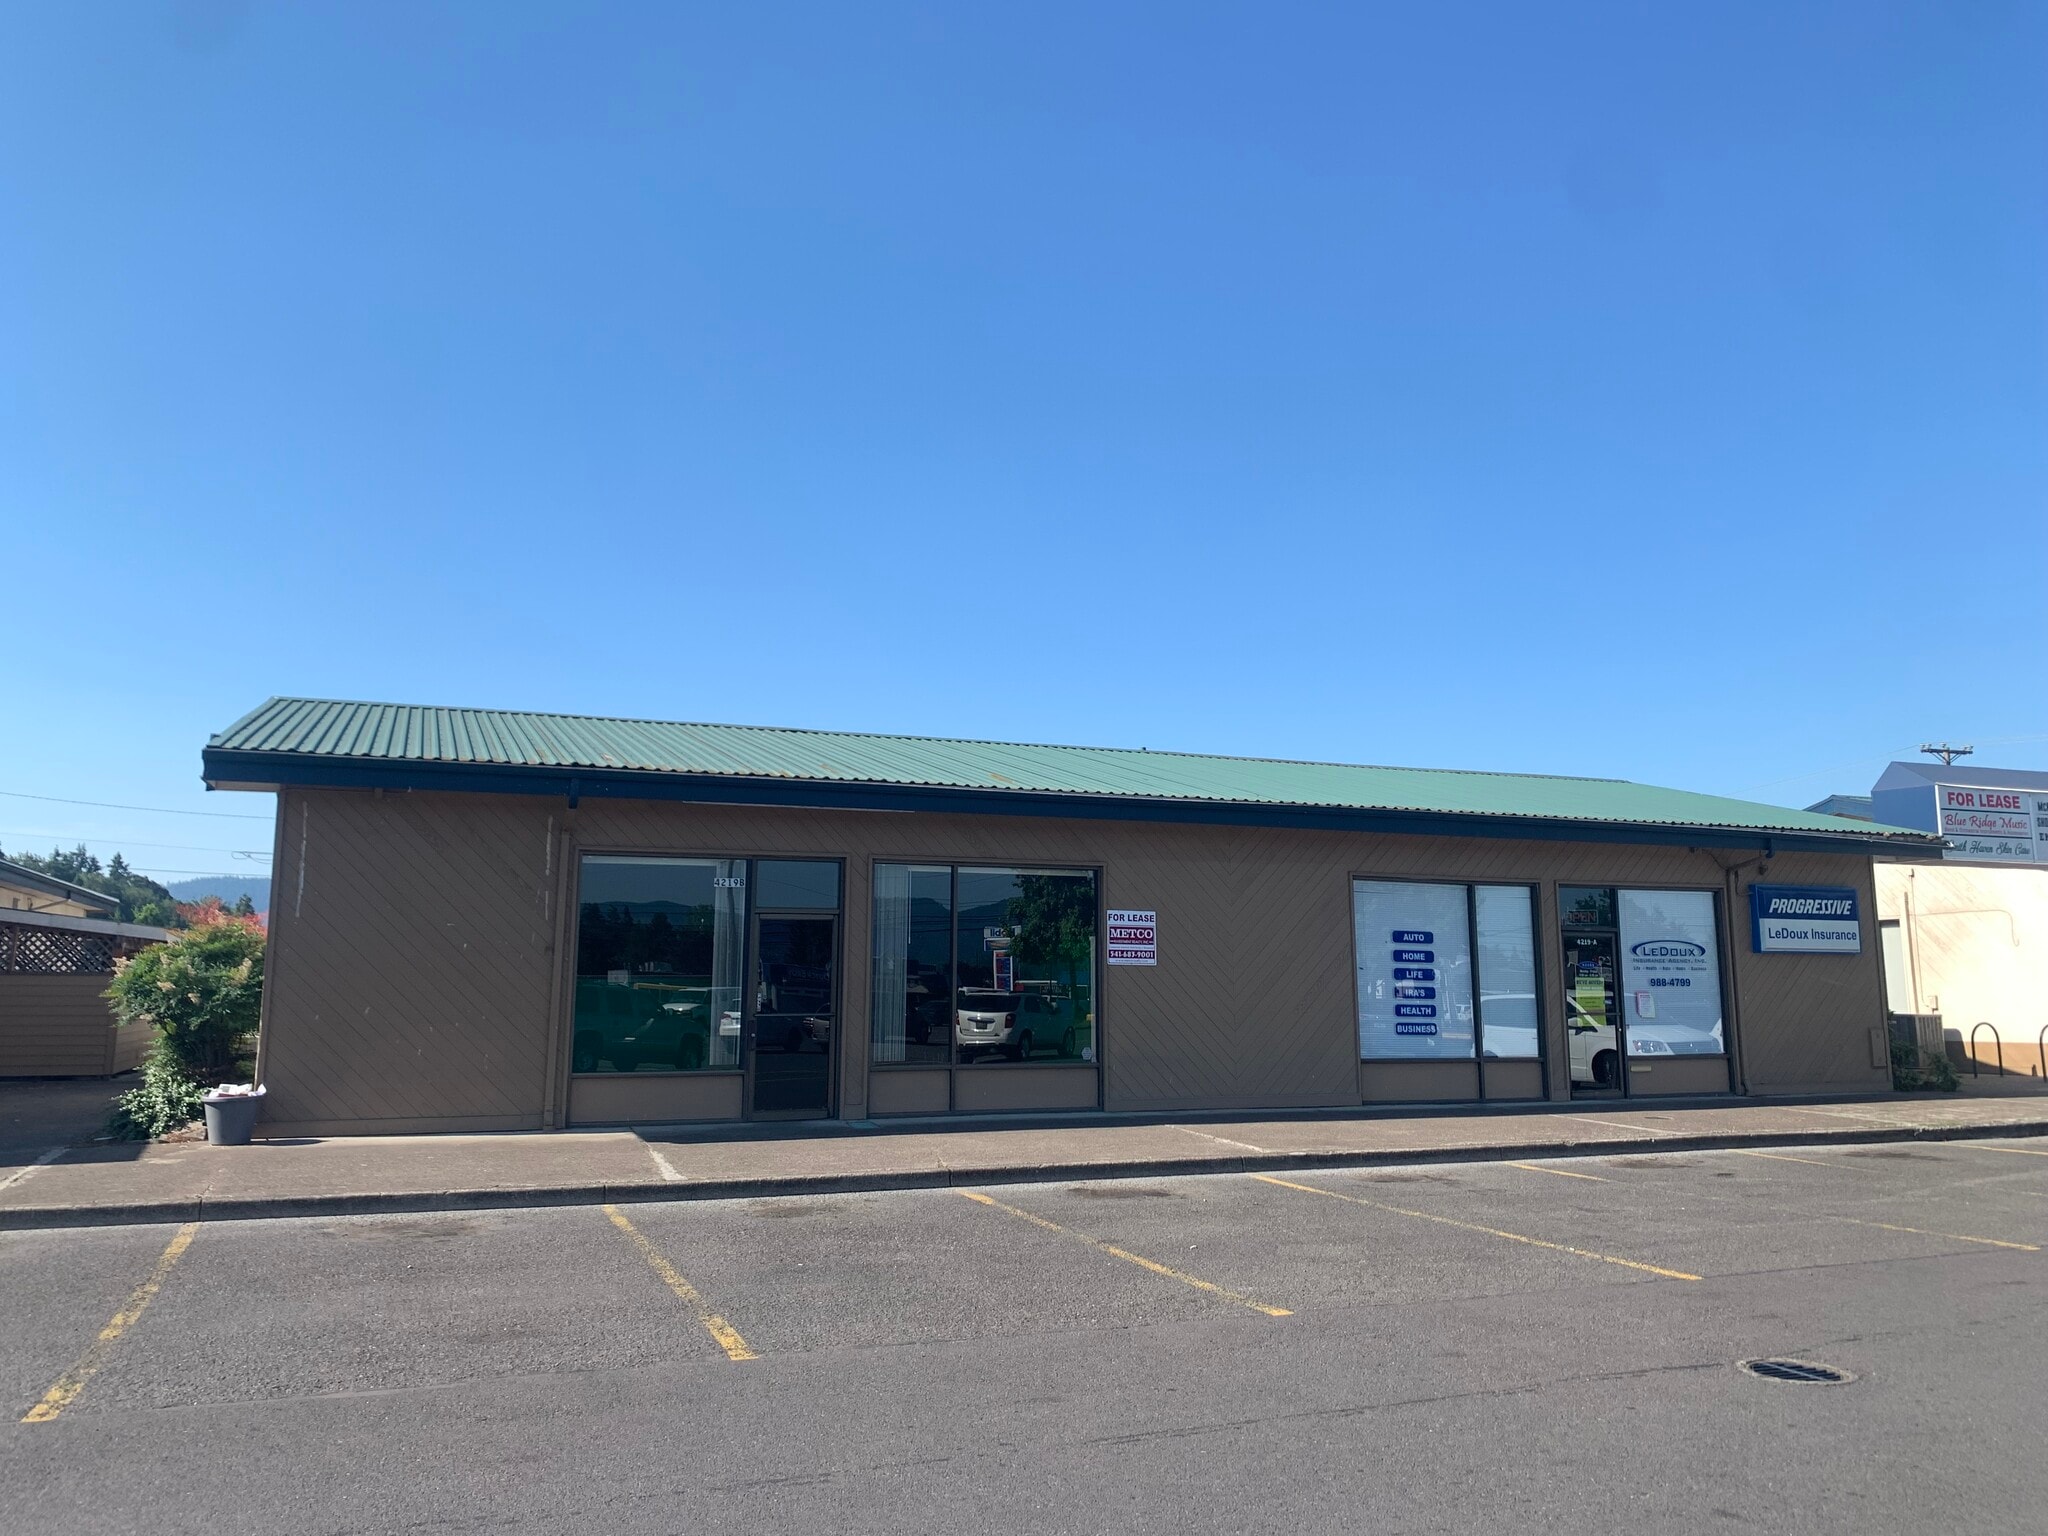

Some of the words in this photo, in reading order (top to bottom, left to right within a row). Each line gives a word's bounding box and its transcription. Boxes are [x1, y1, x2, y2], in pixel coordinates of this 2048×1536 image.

[1947, 792, 1974, 806] FOR
[1979, 794, 2021, 809] LEASE
[1944, 813, 1966, 826] Blue
[1969, 814, 1996, 830] Ridge
[1999, 816, 2027, 829] Music
[1996, 842, 2012, 855] Skin
[714, 878, 745, 886] 4219B
[1768, 898, 1852, 915] PROGRESSIVE
[1128, 914, 1154, 922] LEASE
[1110, 928, 1153, 938] METCO
[1403, 933, 1424, 941] AUTO
[1768, 927, 1809, 939] LeDoux
[1811, 928, 1857, 940] Insurance
[1402, 952, 1425, 960] HOME
[1406, 970, 1423, 978] LIFE
[1650, 978, 1691, 986] 988-4799
[1405, 989, 1425, 997] IRA'S
[1400, 1007, 1431, 1015] HEALTH
[1397, 1024, 1436, 1033] BUSINESS
